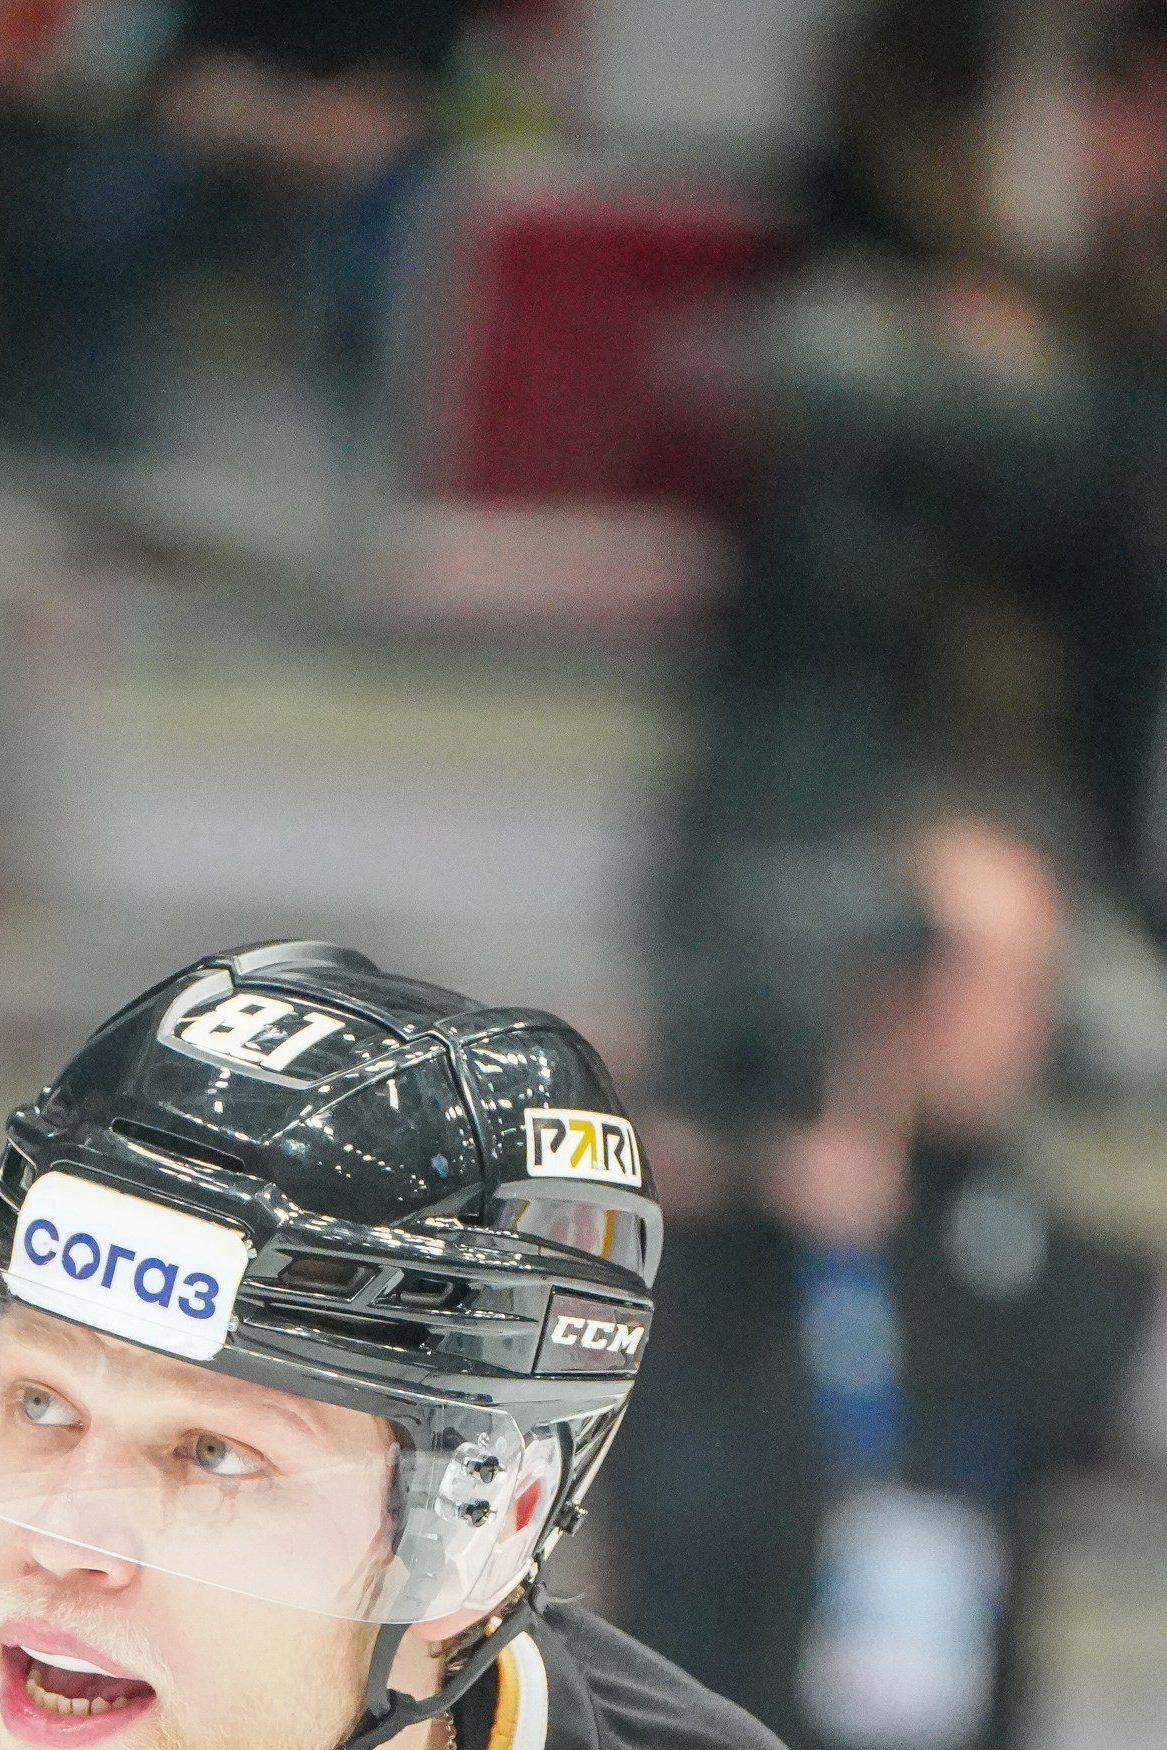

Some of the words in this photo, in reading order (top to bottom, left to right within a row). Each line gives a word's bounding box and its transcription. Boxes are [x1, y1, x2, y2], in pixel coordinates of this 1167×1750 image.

[180, 993, 346, 1072] 81
[24, 1218, 220, 1320] согаз
[550, 1315, 645, 1355] CCM
